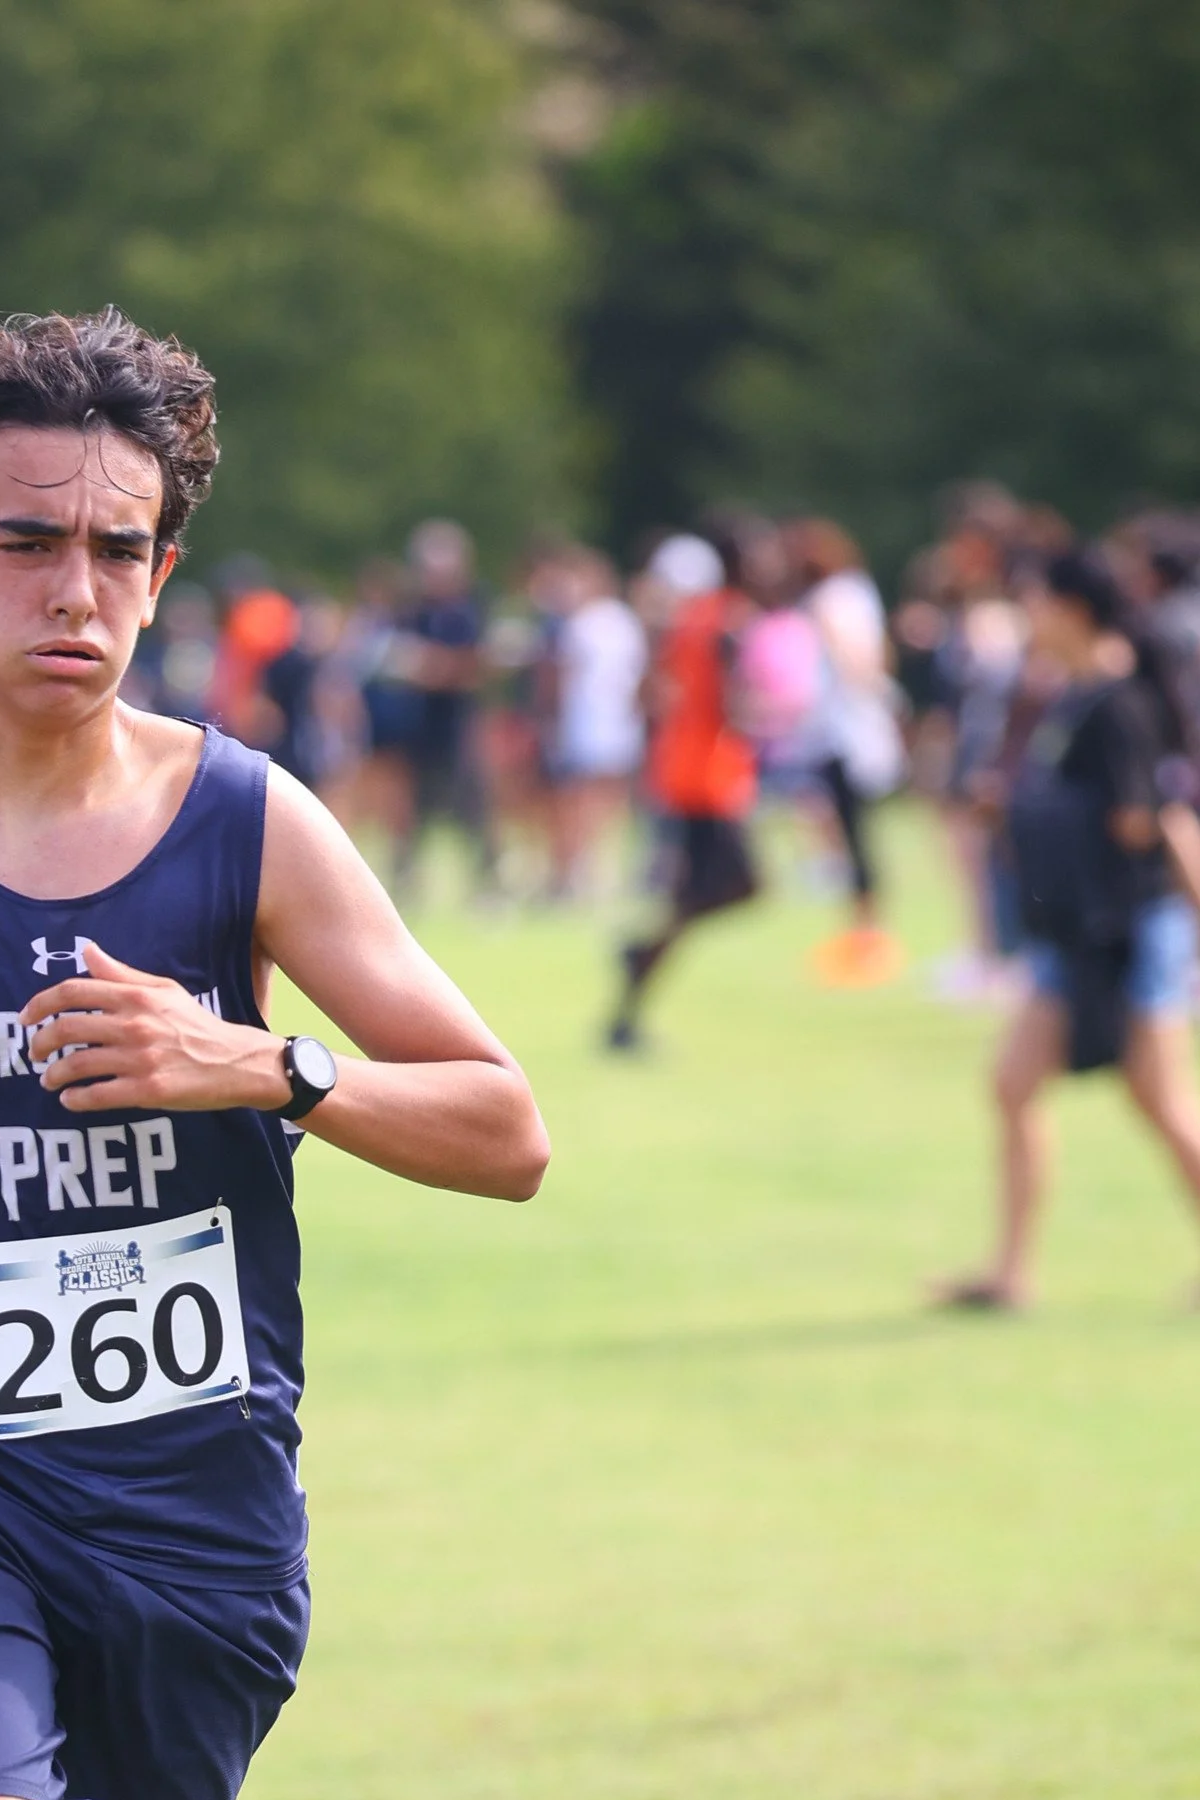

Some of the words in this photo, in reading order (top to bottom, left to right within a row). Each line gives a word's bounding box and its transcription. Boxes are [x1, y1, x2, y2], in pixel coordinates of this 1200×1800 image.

[61, 1261, 116, 1274] GEORGETOWN
[119, 1258, 139, 1268] PREP
[68, 1266, 139, 1289] CLASSIC
